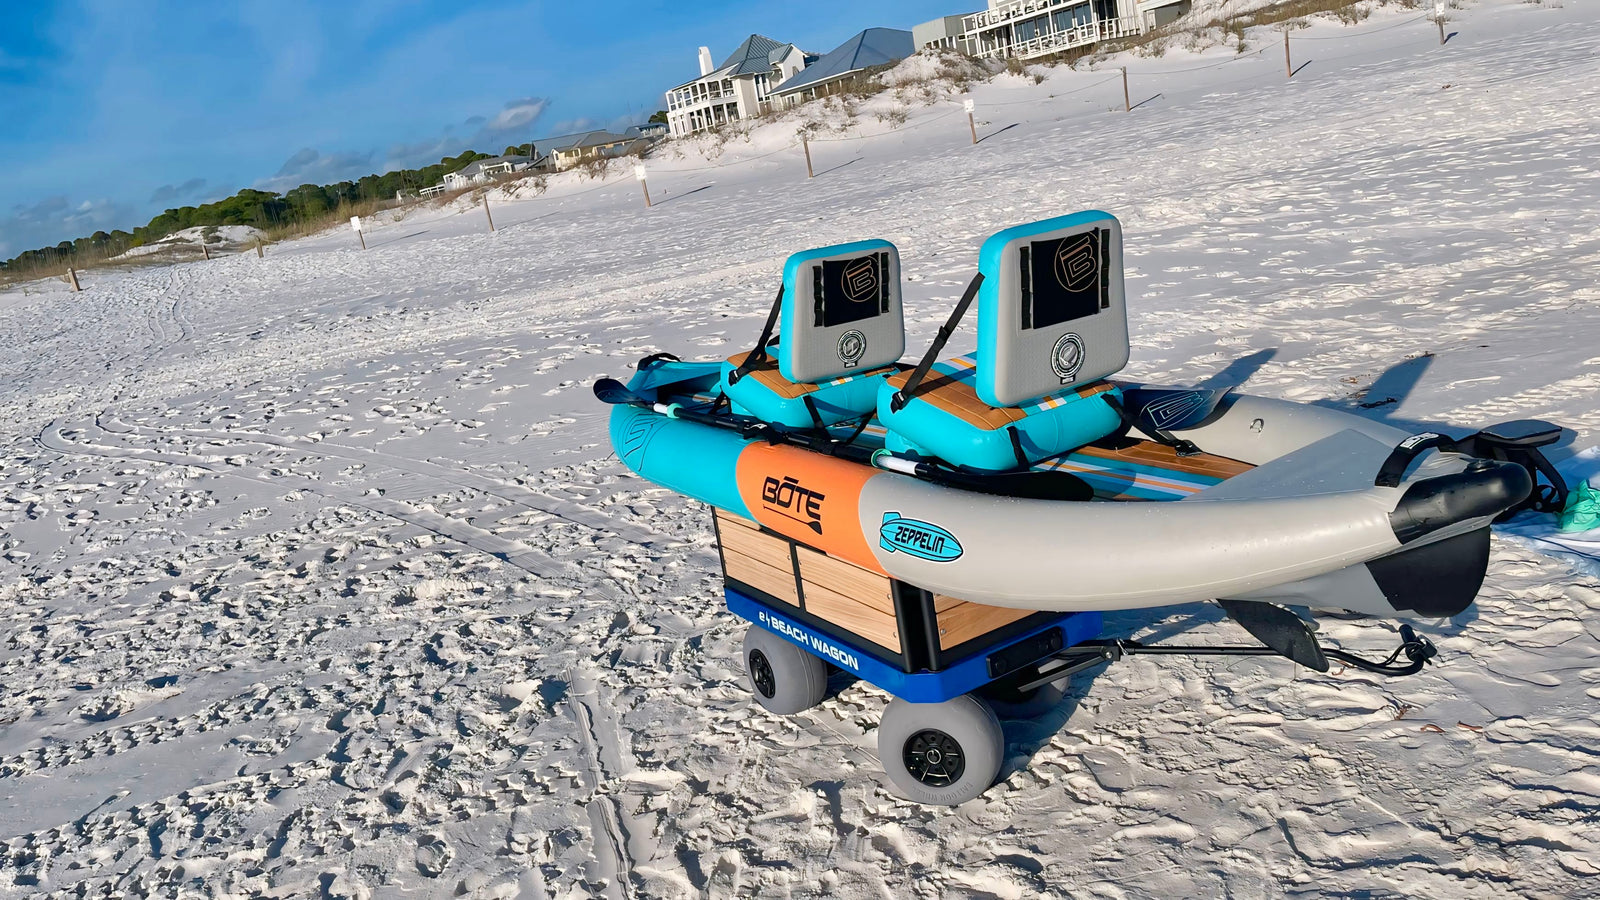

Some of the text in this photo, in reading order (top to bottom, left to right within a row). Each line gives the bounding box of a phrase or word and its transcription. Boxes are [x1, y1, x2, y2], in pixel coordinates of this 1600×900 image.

[894, 525, 945, 554] ZEPPELIN
[771, 616, 809, 645] BEACH
[810, 635, 859, 671] WAGON
